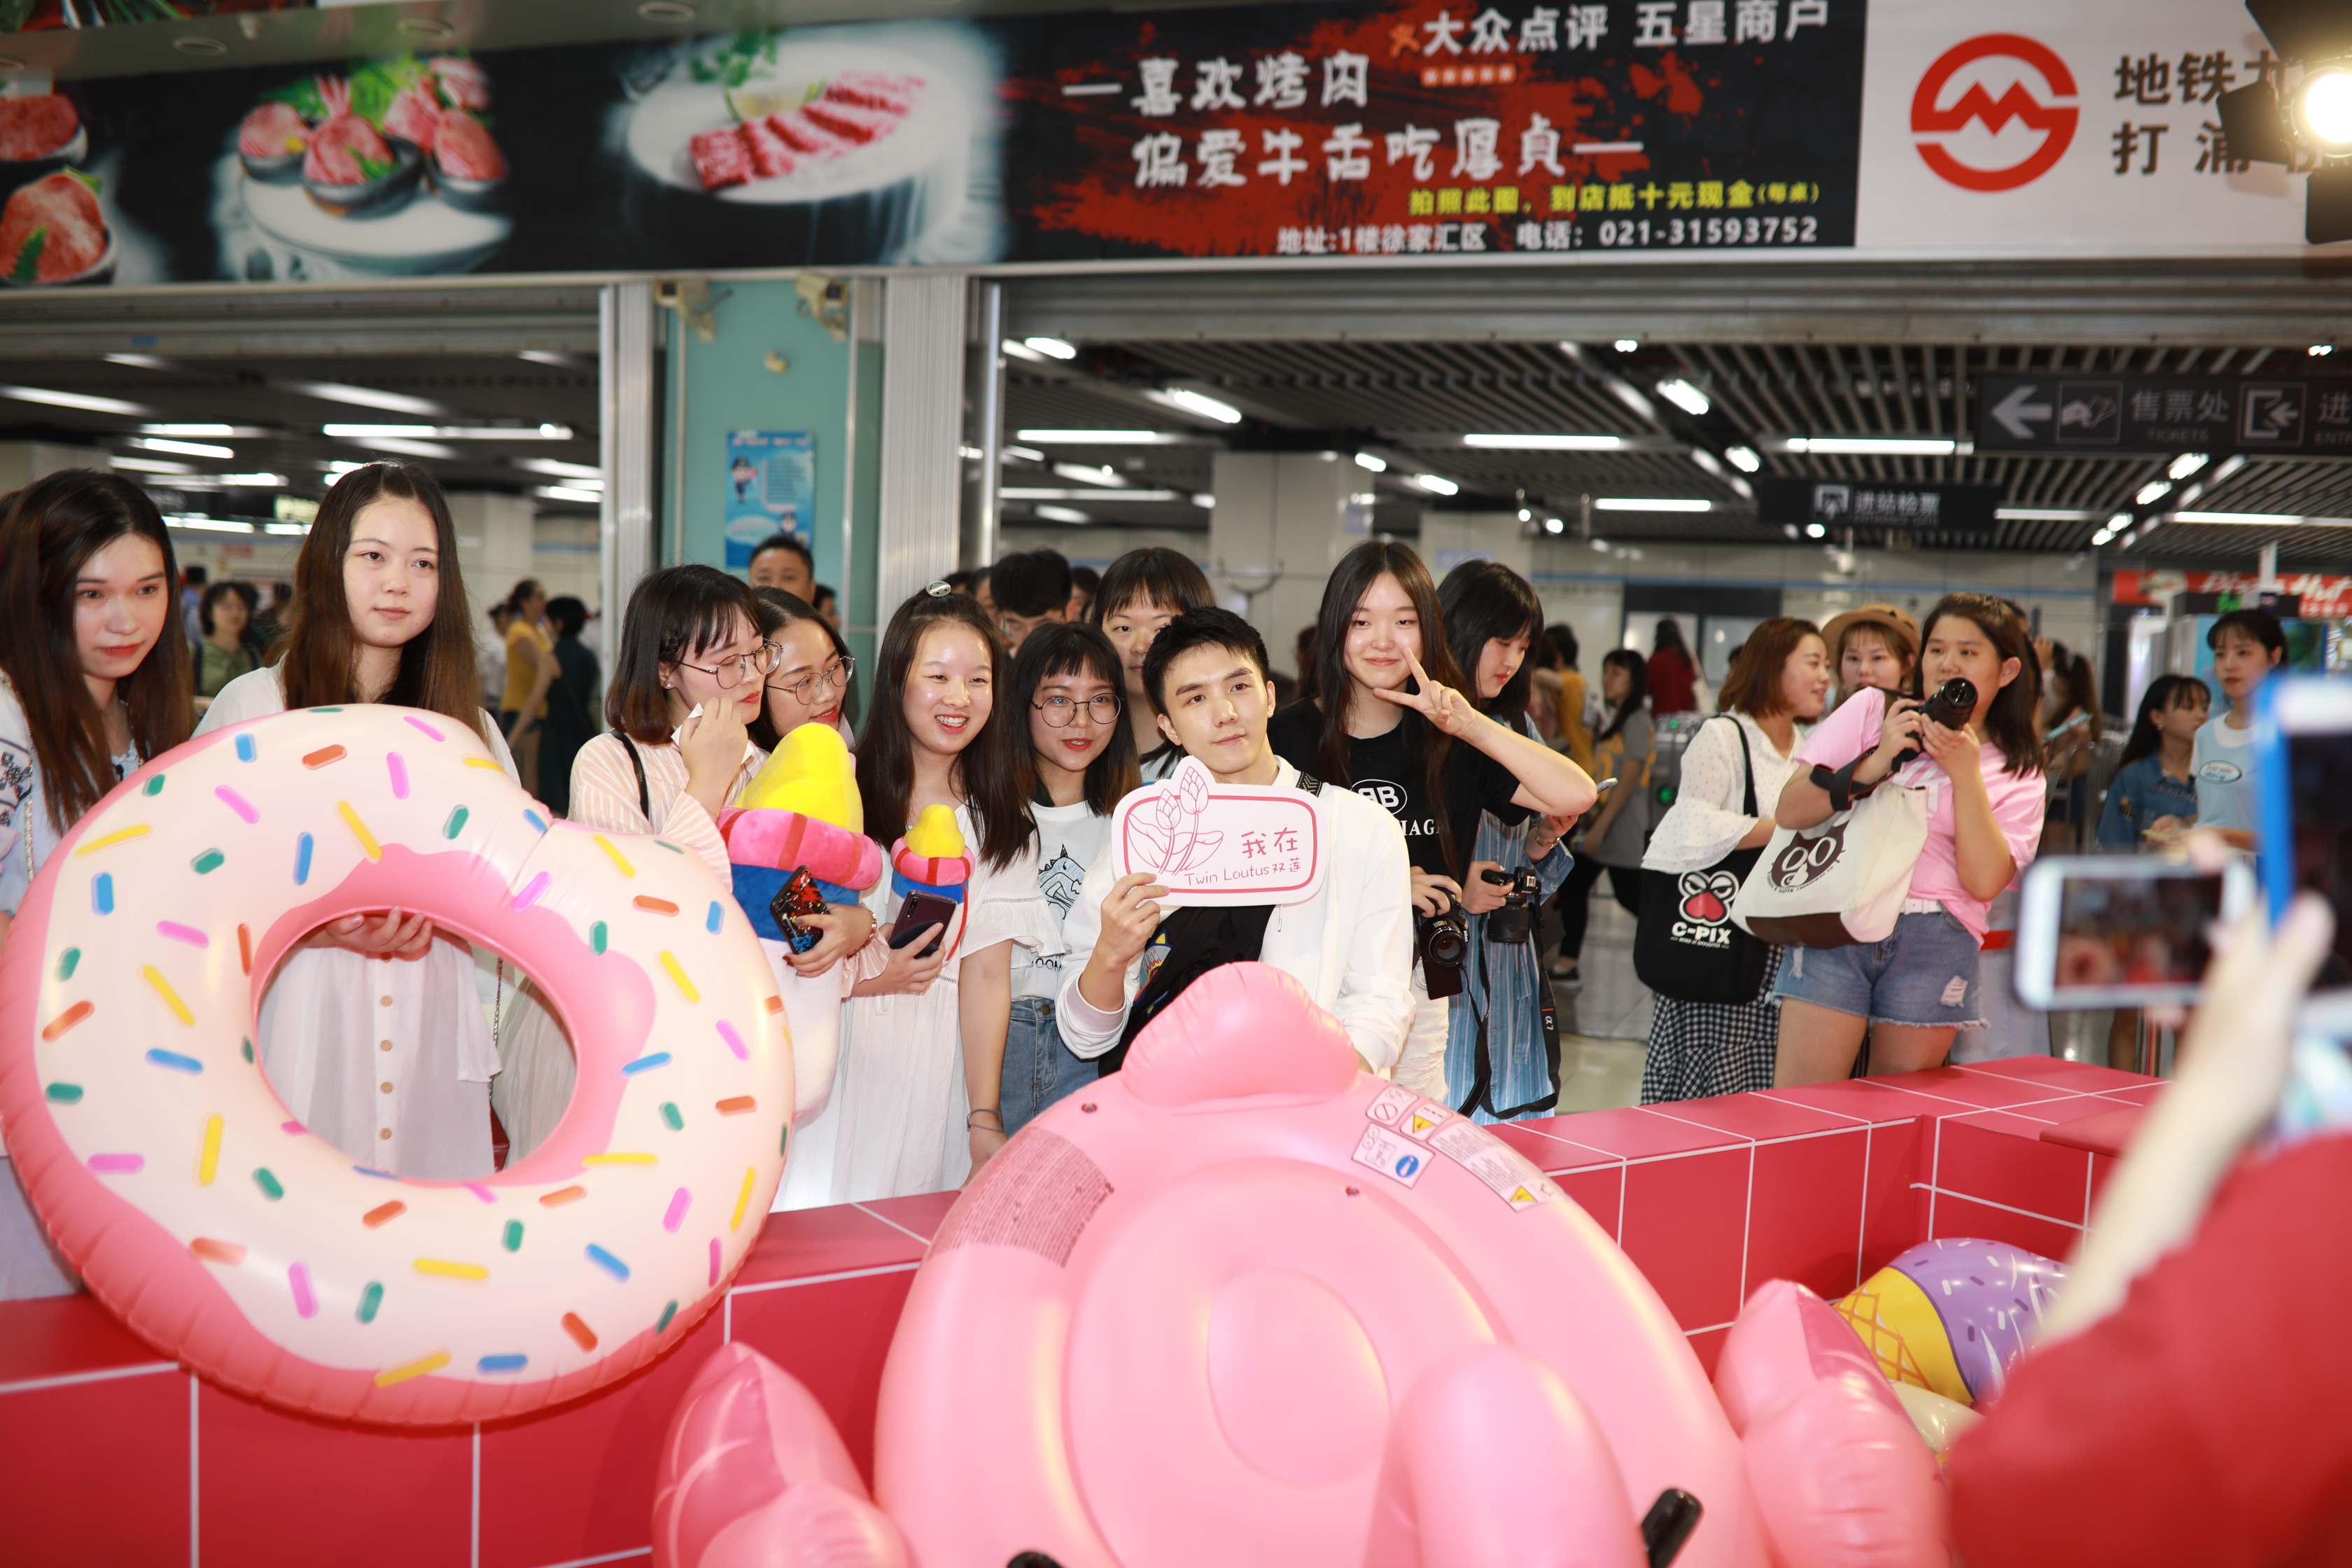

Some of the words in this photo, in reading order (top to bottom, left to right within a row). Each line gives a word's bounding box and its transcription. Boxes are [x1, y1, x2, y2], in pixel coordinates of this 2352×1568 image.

[1422, 4, 1609, 57] 大众点评
[1633, 0, 1829, 47] 五星商户
[1130, 50, 1370, 117] 喜欢烤肉
[1598, 216, 1819, 247] 021-31593752
[2130, 388, 2230, 423] 售票处
[2147, 427, 2210, 444] TICKETS
[1241, 827, 1298, 859] 我在
[1184, 871, 1218, 886] Twin
[1224, 865, 1270, 881] Loutus
[1672, 921, 1732, 945] C-PIX
